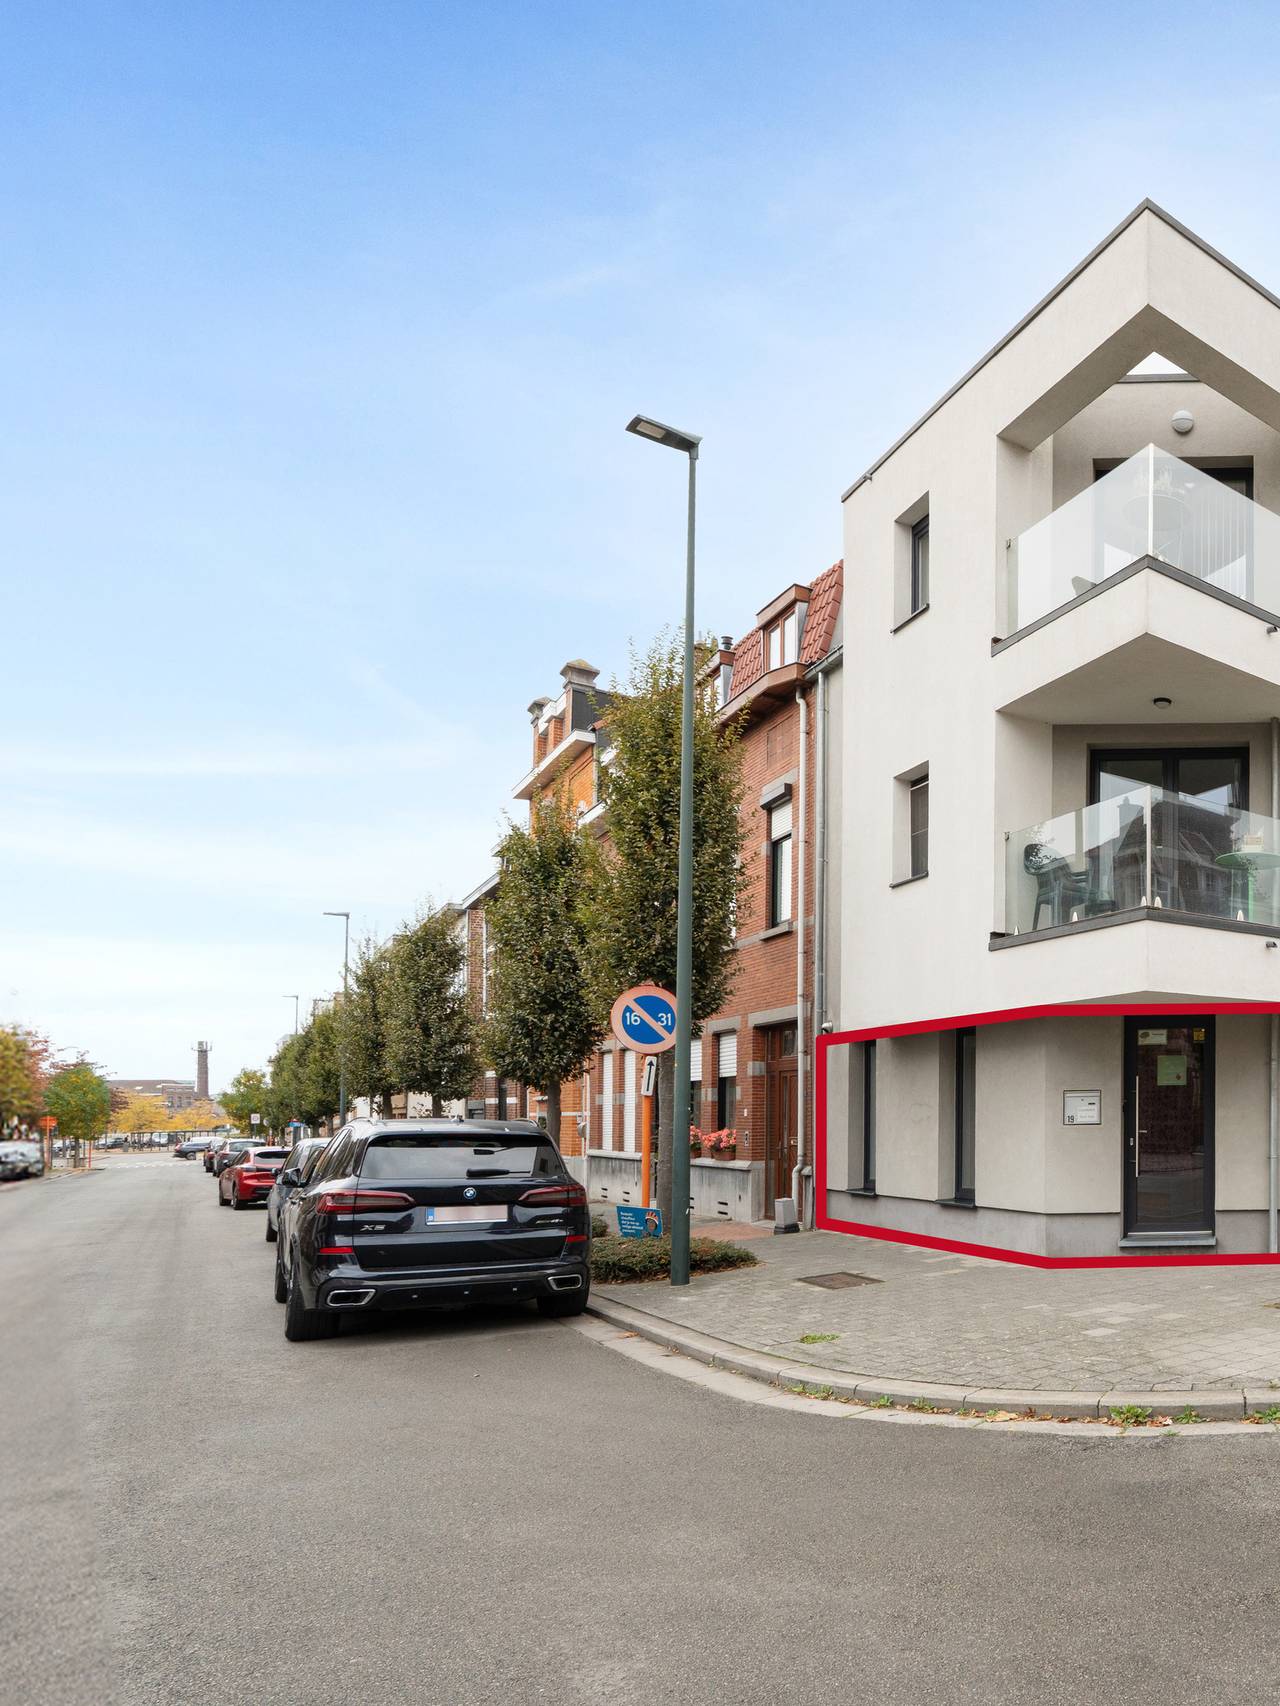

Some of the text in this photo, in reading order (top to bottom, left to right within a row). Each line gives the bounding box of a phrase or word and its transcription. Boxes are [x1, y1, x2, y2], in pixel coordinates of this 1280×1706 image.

[625, 1012, 672, 1026] 16 31
[1067, 1115, 1075, 1124] 19
